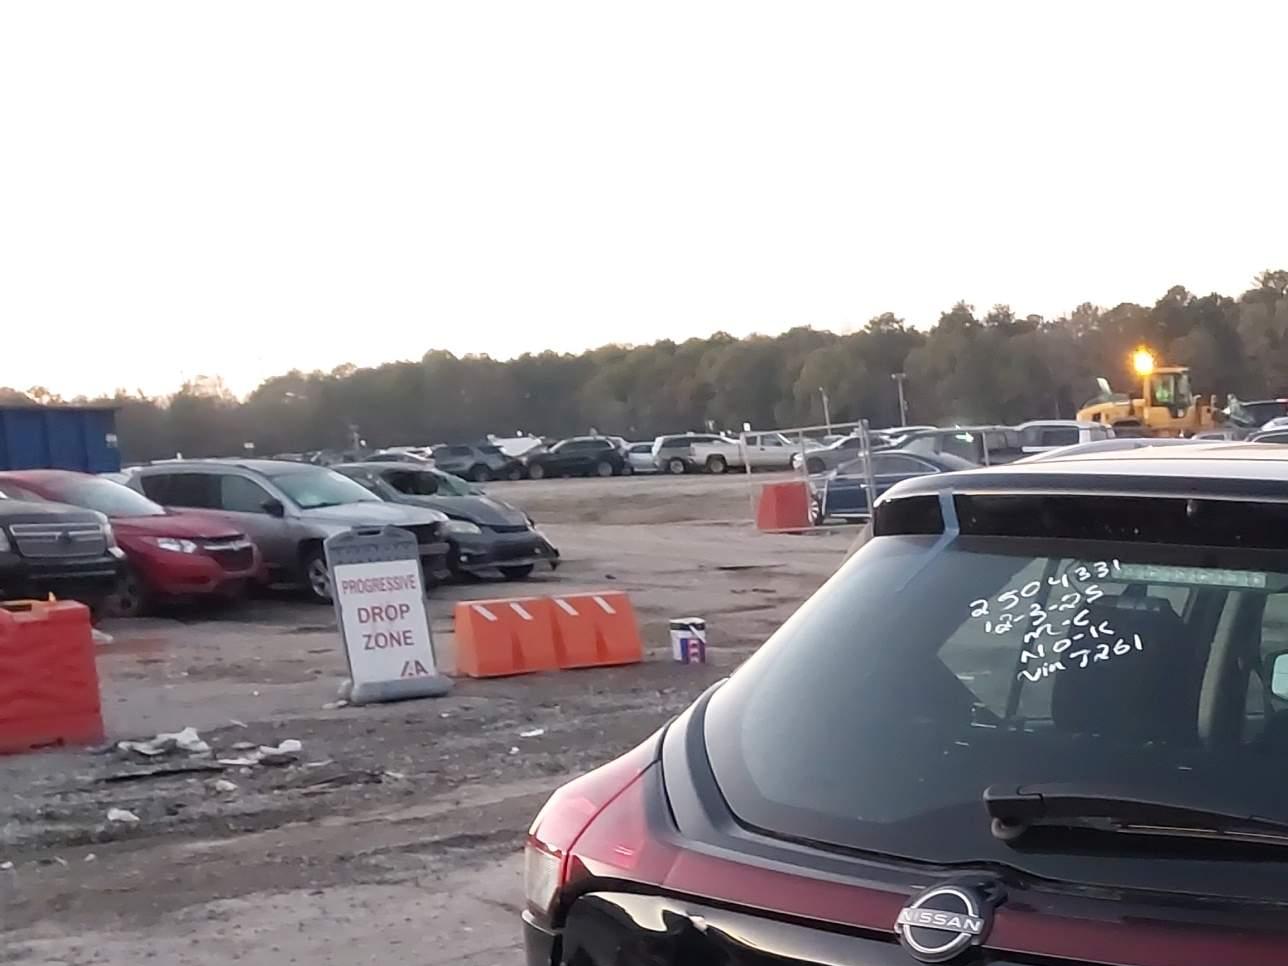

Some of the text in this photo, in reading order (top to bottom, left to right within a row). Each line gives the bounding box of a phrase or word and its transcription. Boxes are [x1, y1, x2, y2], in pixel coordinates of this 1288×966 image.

[341, 574, 417, 594] PROGRESSIVE
[969, 559, 1121, 617] 2504331
[357, 603, 411, 624] DROP
[984, 584, 1104, 634] 12-3-25
[362, 630, 415, 651] ZONE
[902, 911, 981, 932] NISSAN
